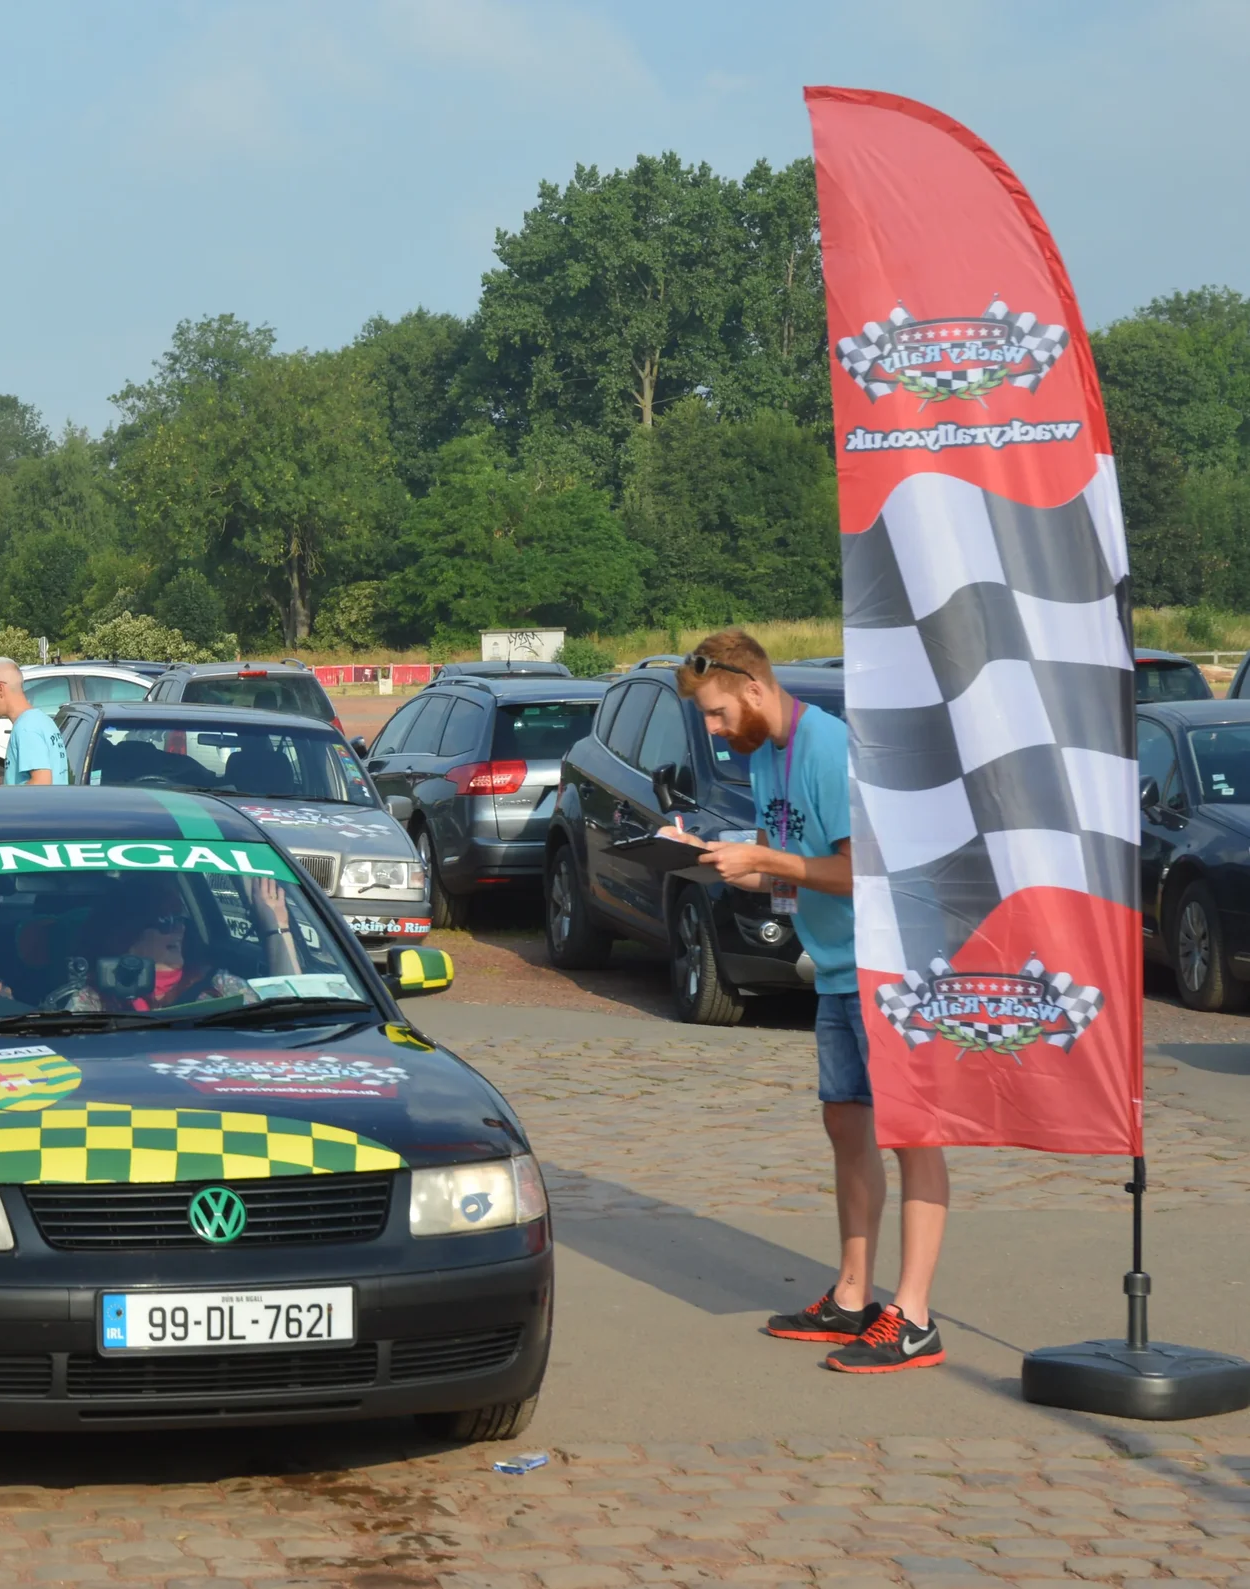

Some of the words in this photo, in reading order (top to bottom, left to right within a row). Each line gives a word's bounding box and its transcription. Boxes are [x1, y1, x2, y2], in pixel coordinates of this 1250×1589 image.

[386, 922, 402, 932] to
[200, 1065, 287, 1075] Wacky
[292, 1065, 368, 1077] Rally
[148, 1303, 333, 1342] 99-DL-7621
[106, 1327, 124, 1340] IRL
